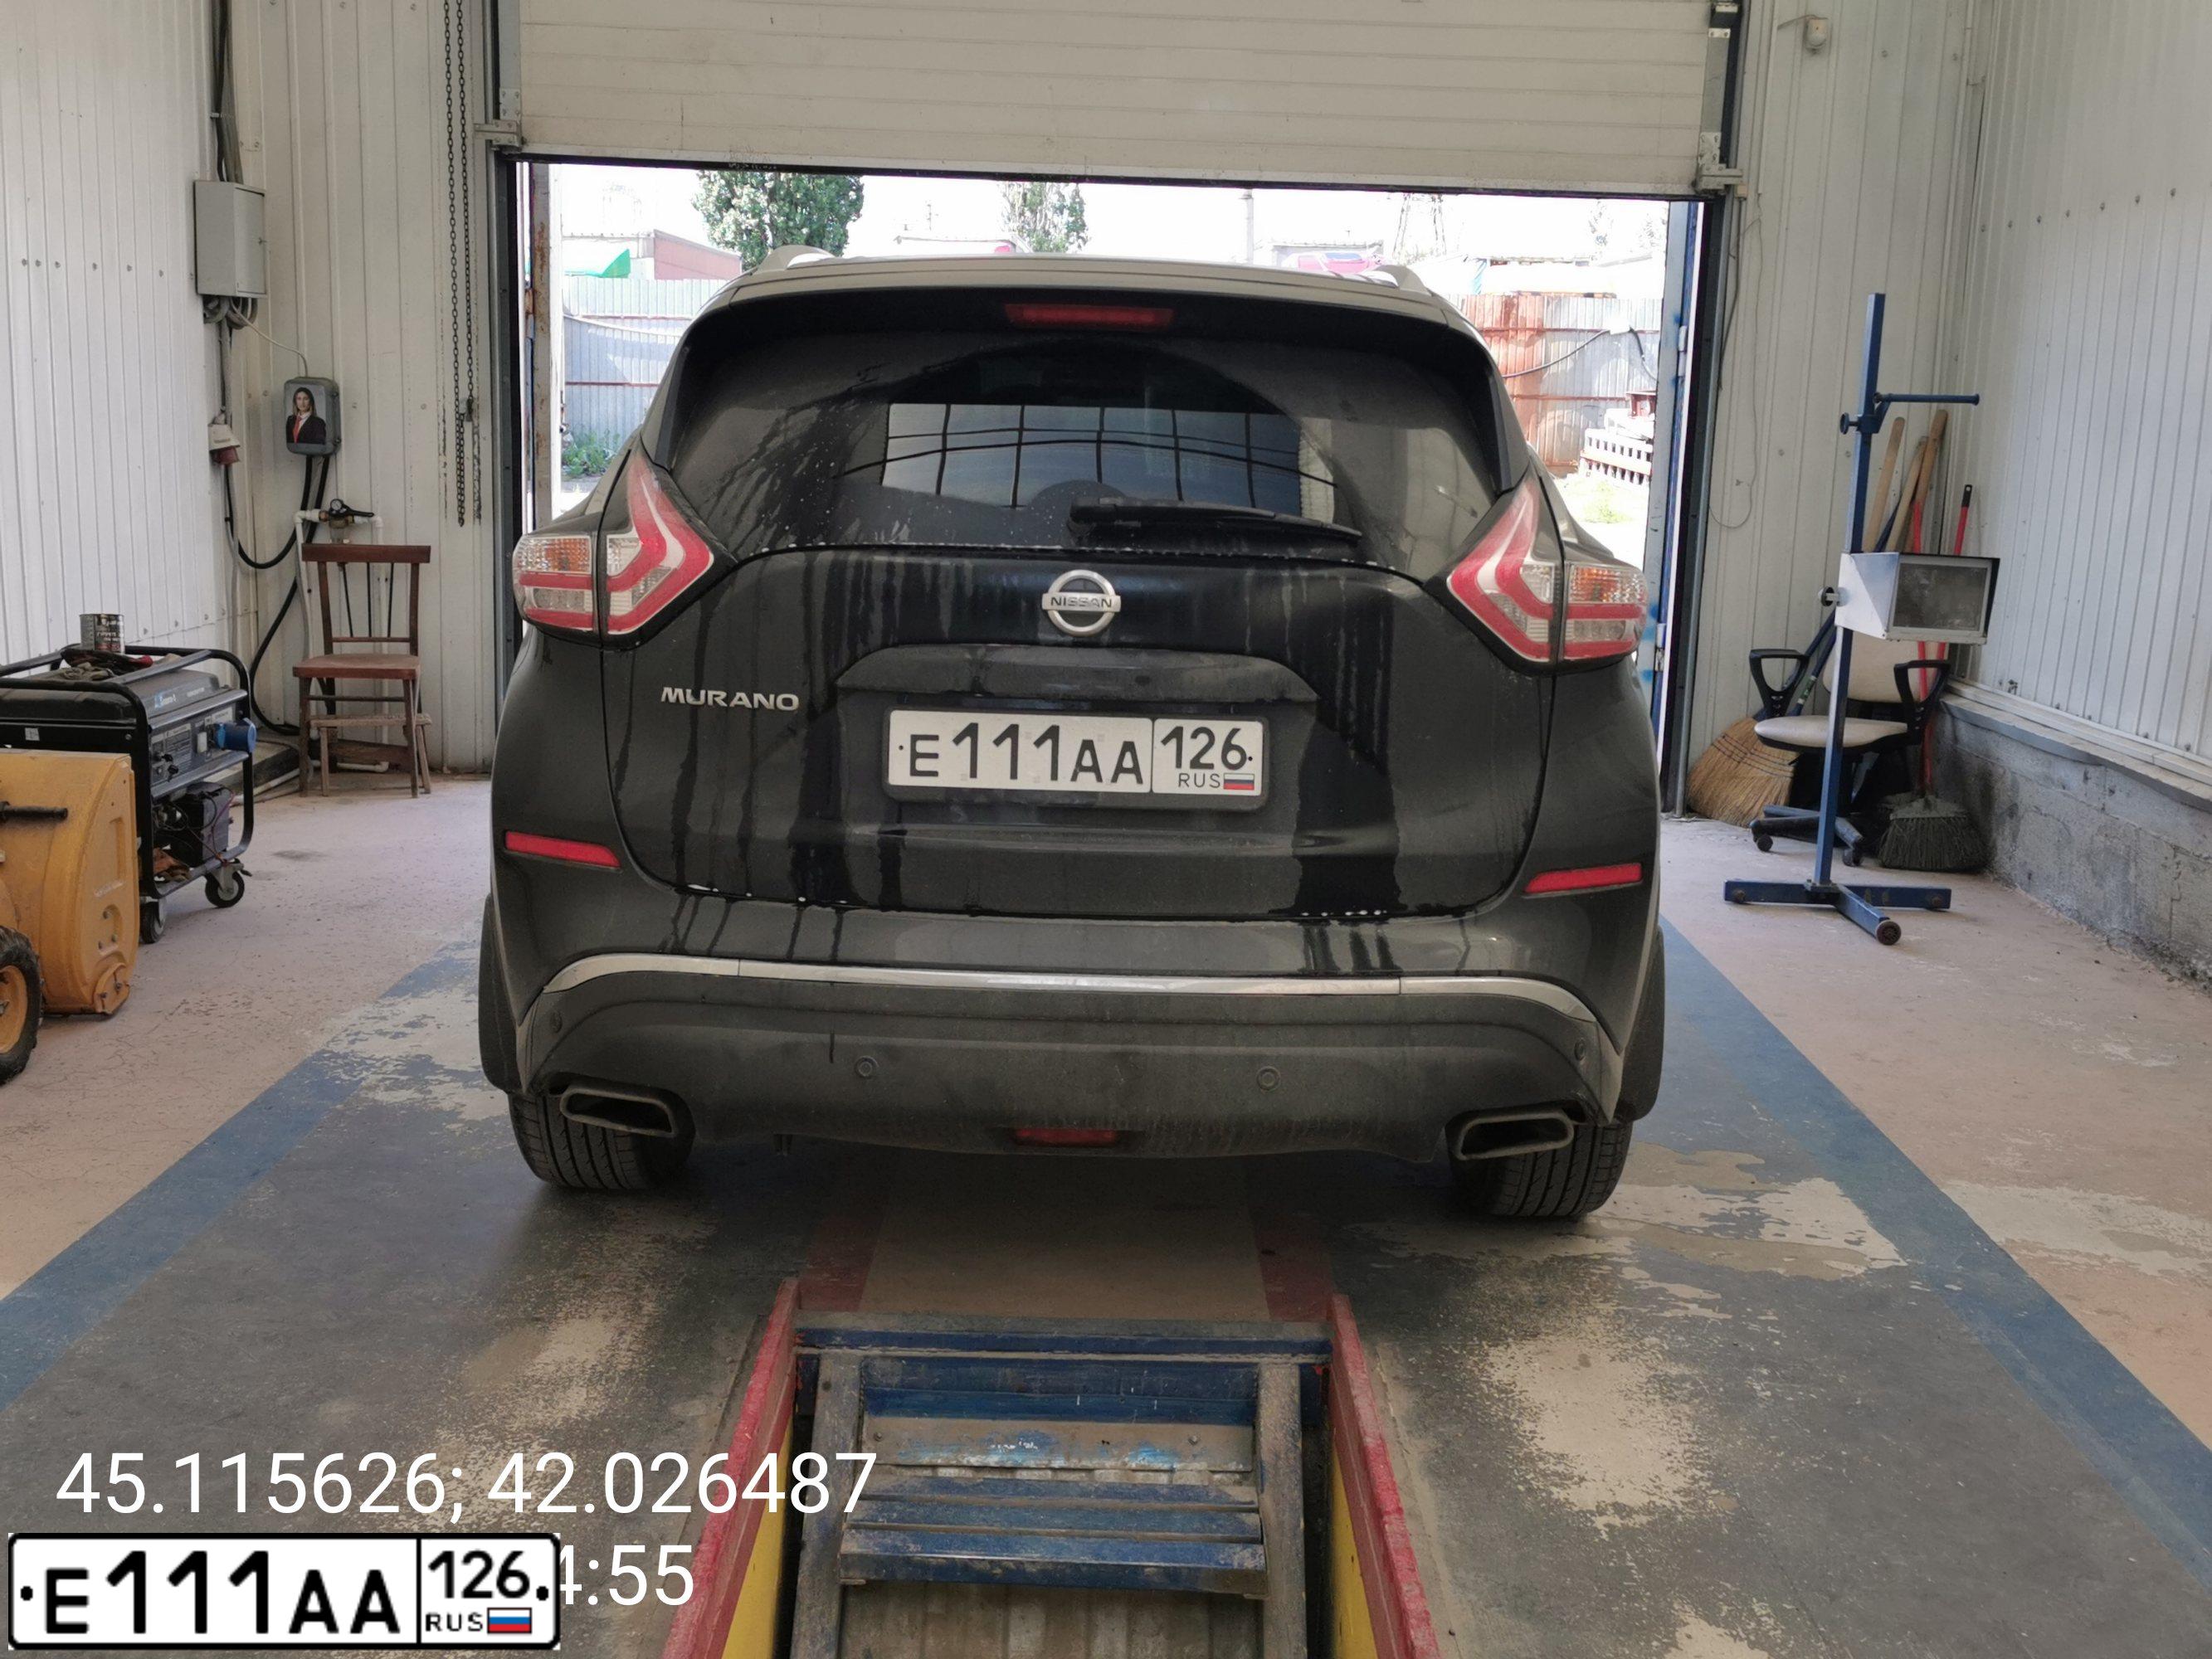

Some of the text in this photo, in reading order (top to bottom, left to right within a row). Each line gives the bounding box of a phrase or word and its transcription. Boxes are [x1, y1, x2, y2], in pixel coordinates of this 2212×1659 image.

[1050, 596, 1113, 610] NISSAN
[660, 686, 800, 713] MURANO
[1161, 726, 1247, 771] 126
[1177, 772, 1220, 789] RUS
